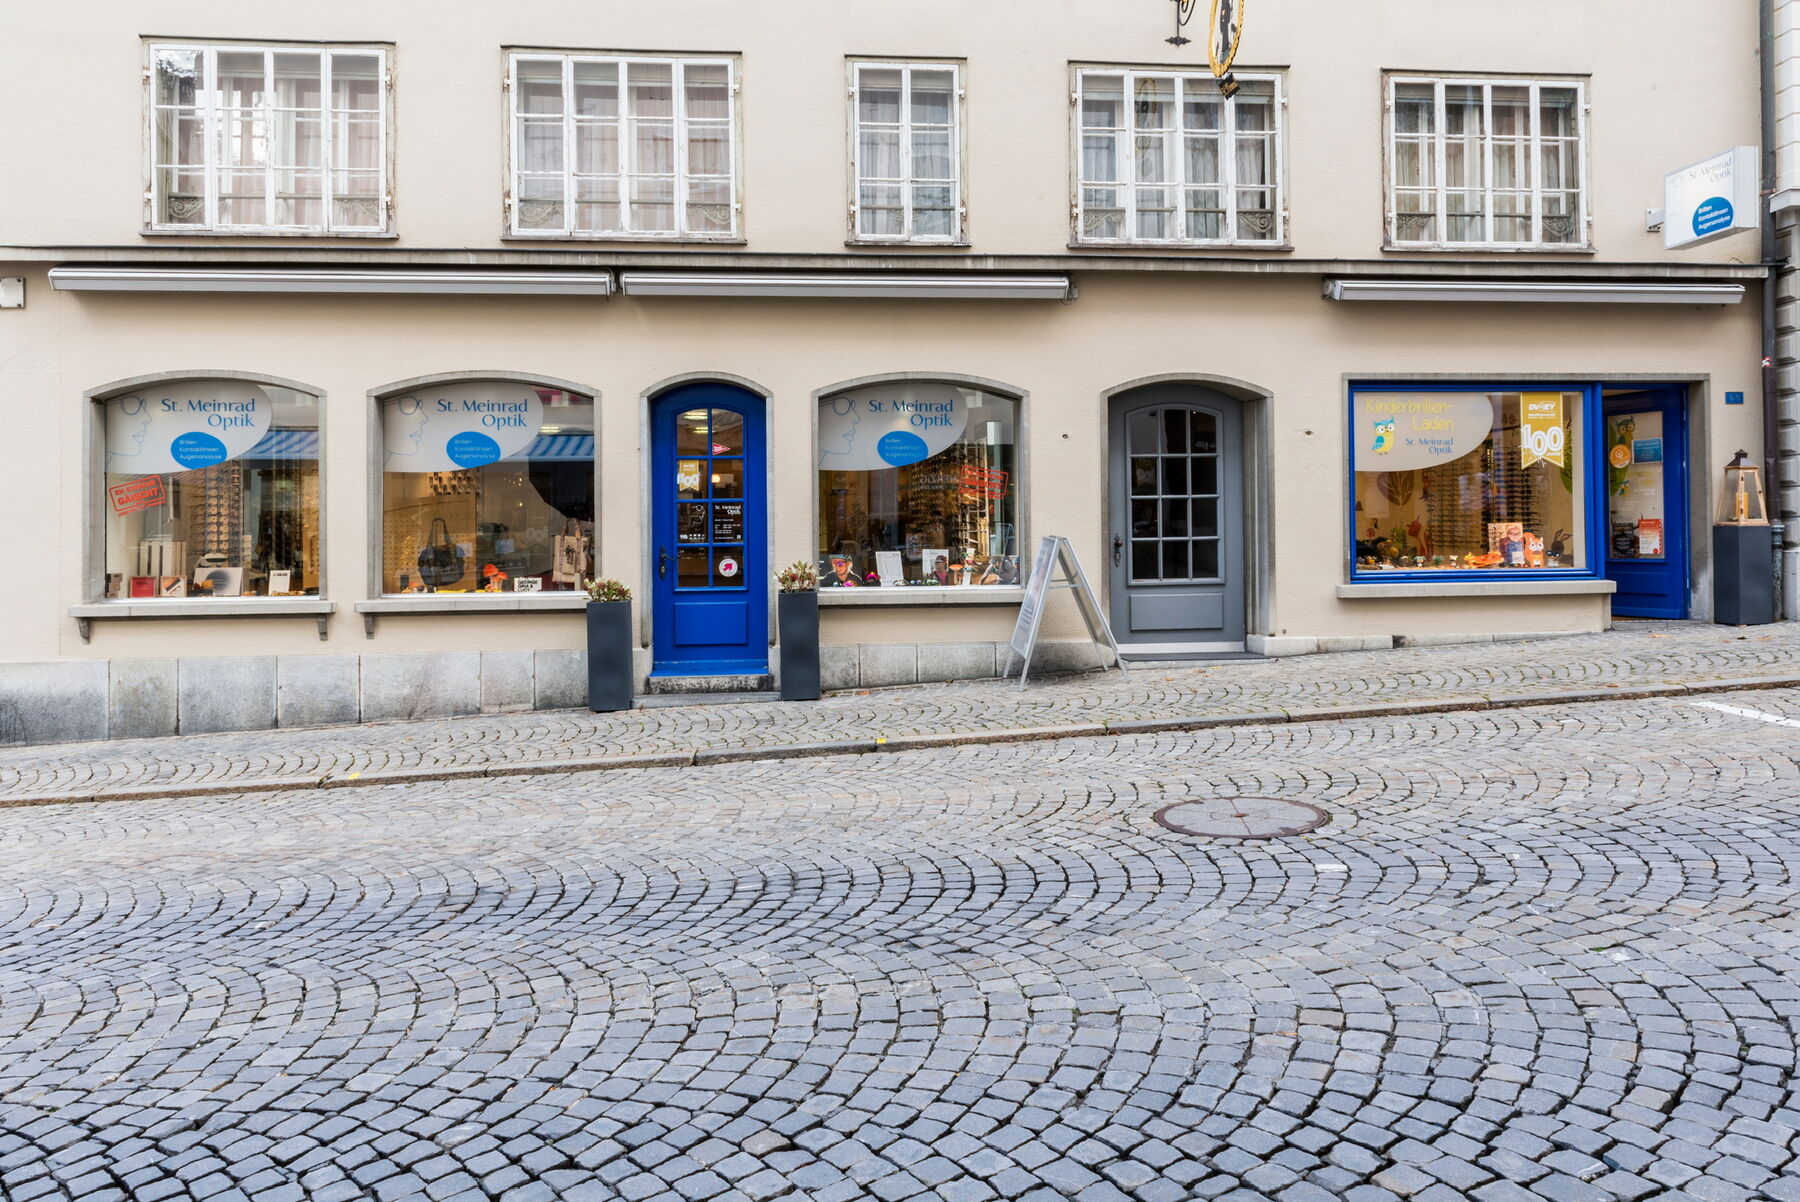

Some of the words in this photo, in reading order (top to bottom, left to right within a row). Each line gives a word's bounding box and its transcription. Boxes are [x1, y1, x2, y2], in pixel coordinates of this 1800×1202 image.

[1710, 167, 1732, 183] Optik
[161, 398, 182, 412] St.
[187, 397, 256, 412] Meinrad
[437, 398, 457, 412] St.
[462, 398, 528, 412] Meinrad
[868, 399, 888, 412] St.
[892, 398, 954, 412] Meinrad
[1365, 398, 1453, 414] Kinderbrillen-
[207, 413, 256, 431] Optik
[481, 413, 528, 431] Optik
[910, 413, 953, 430] Optik
[1411, 416, 1454, 432] Laden
[1419, 437, 1453, 446] Meinrad
[1520, 423, 1565, 456] 100
[1428, 446, 1453, 456] Optik
